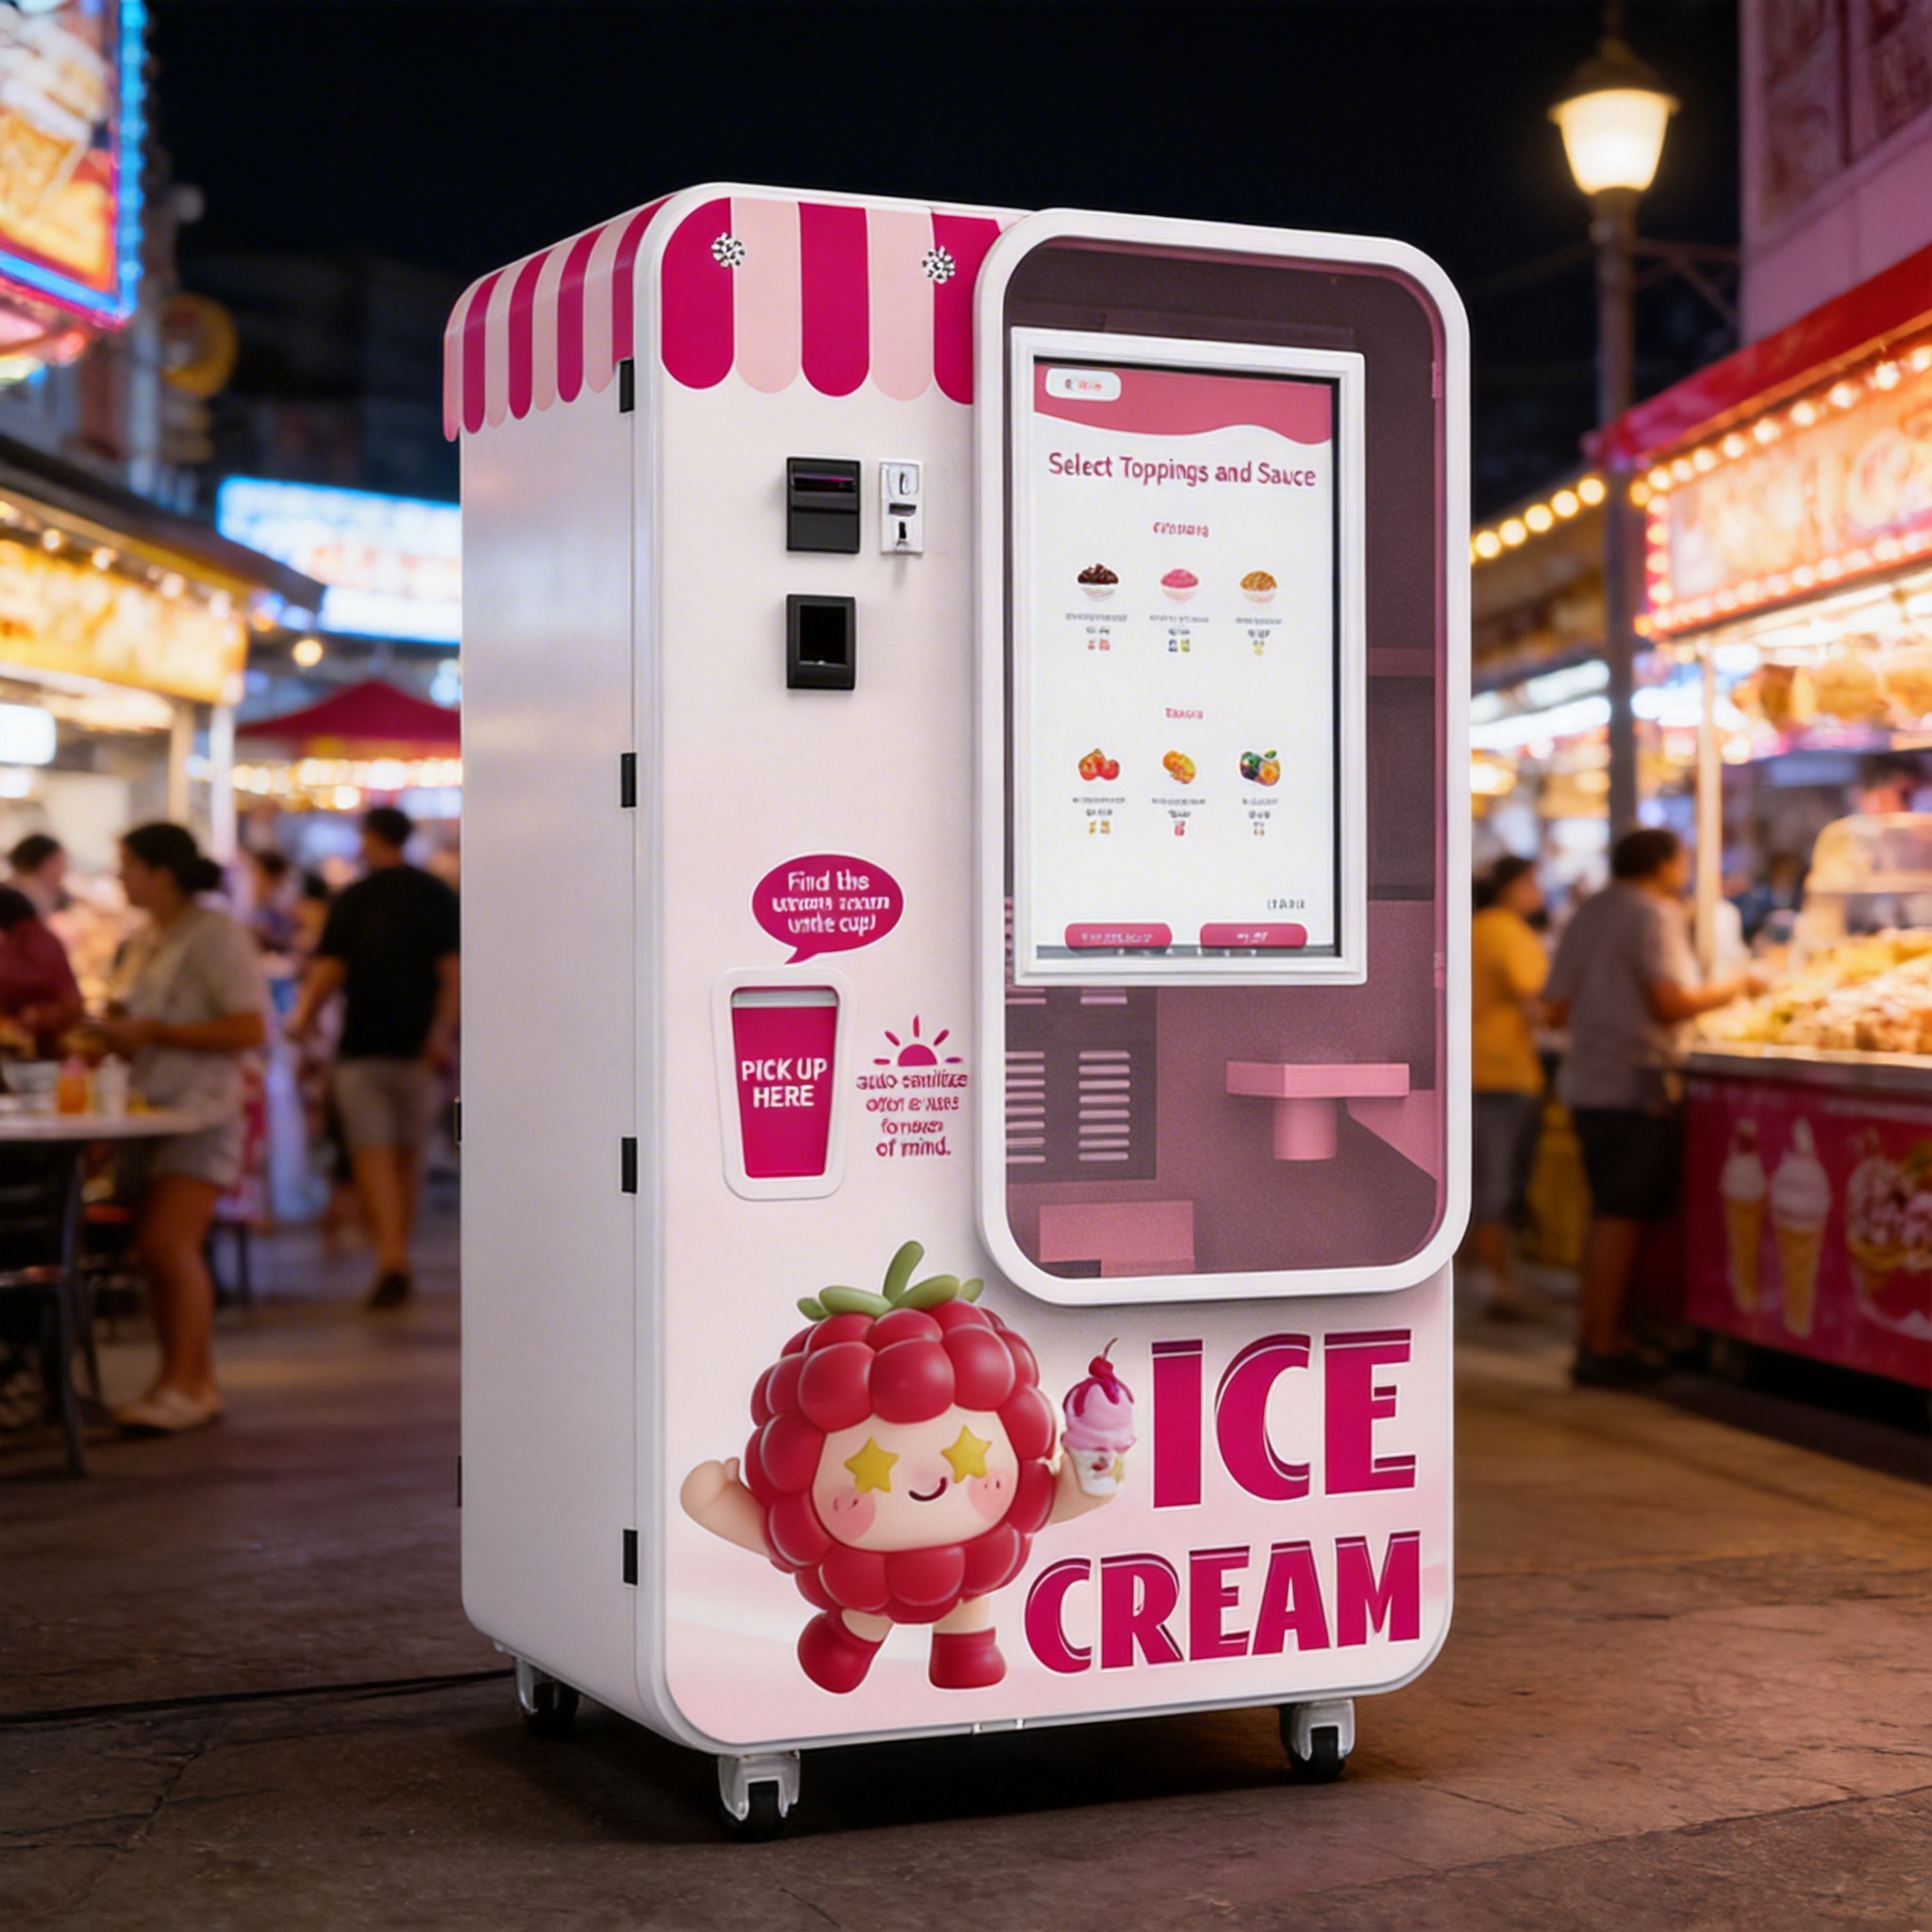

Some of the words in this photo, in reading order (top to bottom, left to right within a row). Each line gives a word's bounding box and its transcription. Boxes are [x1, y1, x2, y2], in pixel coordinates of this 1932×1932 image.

[1048, 452, 1112, 478] Select
[1120, 457, 1208, 487] Toppings
[1215, 460, 1252, 483] and
[1257, 462, 1317, 487] Sauce
[788, 870, 830, 891] Find
[741, 1058, 792, 1082] PICK
[796, 1058, 827, 1081] UP
[753, 1085, 814, 1108] HERE
[875, 1138, 897, 1158] of
[901, 1136, 952, 1158] mind.
[1152, 1328, 1416, 1509] ICE
[1024, 1530, 1422, 1674] CREAM
